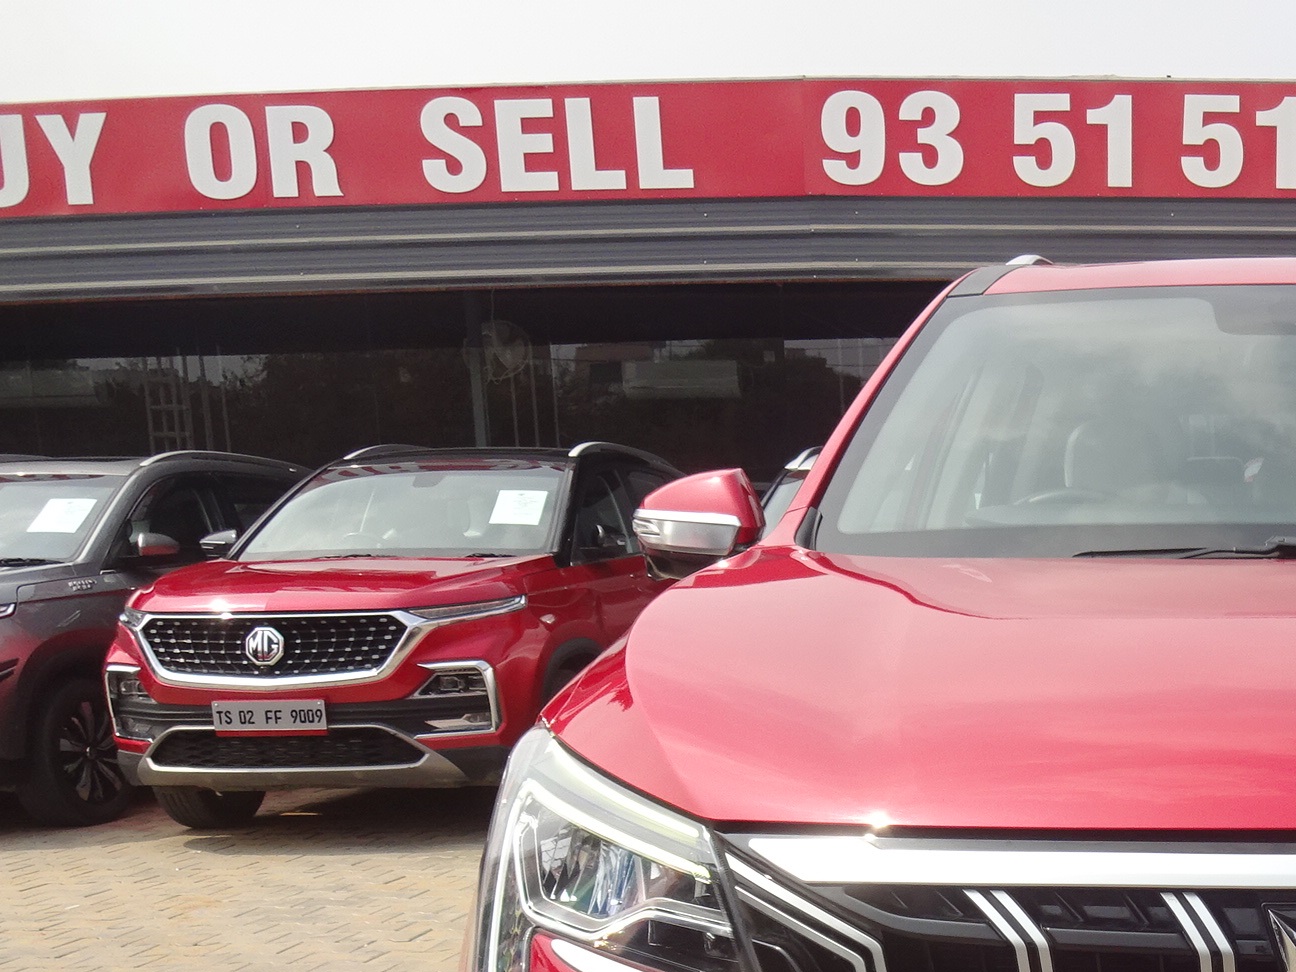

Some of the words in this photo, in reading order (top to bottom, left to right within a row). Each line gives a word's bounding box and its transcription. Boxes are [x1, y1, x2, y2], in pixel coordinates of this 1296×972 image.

[184, 104, 344, 200] OR
[419, 96, 695, 193] SELL
[820, 90, 964, 187] 93
[1011, 93, 1133, 188] 51
[248, 629, 279, 661] MG
[216, 710, 233, 725] TS
[239, 709, 255, 725] 02
[265, 708, 282, 725] FF
[290, 708, 323, 724] 9009
